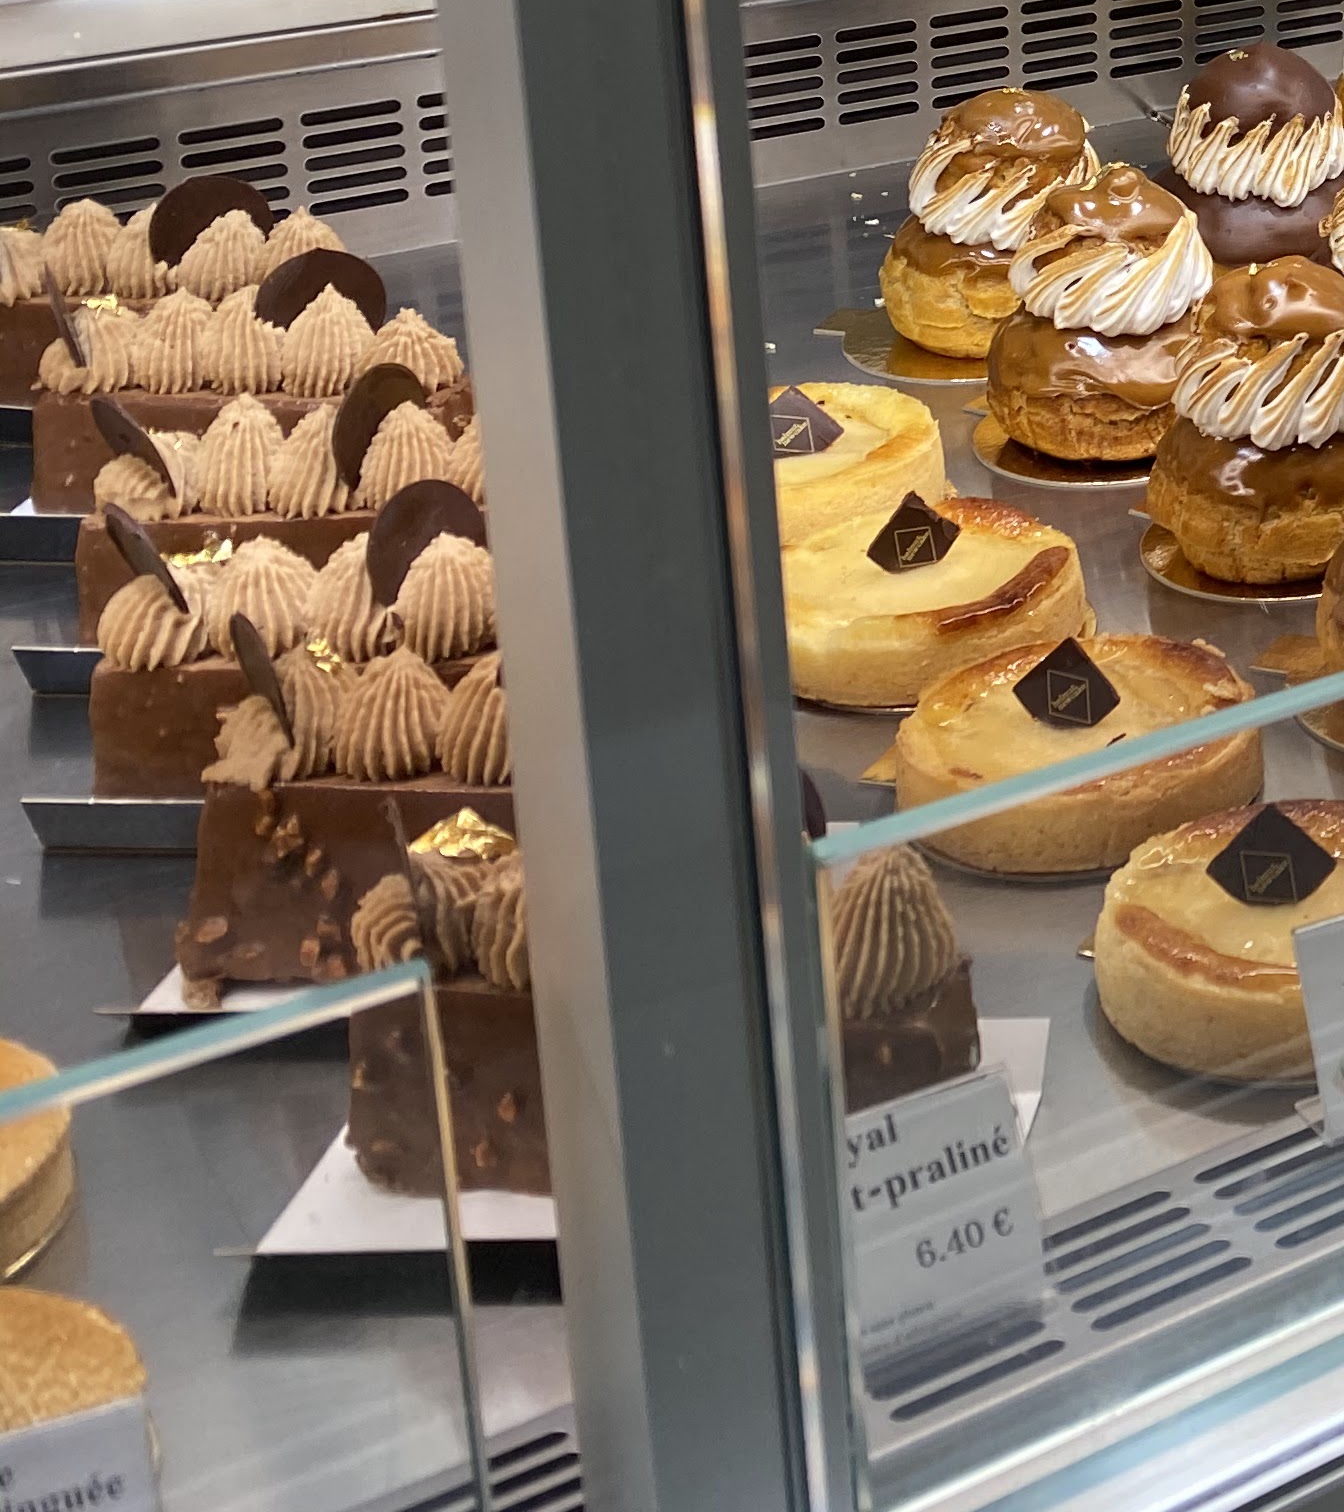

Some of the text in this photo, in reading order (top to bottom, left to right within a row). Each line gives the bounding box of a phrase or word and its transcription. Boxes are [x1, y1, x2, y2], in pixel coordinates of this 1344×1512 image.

[846, 1113, 898, 1169] yal
[850, 1123, 1011, 1212] t-praliné
[915, 1207, 1015, 1269] 6.40 €
